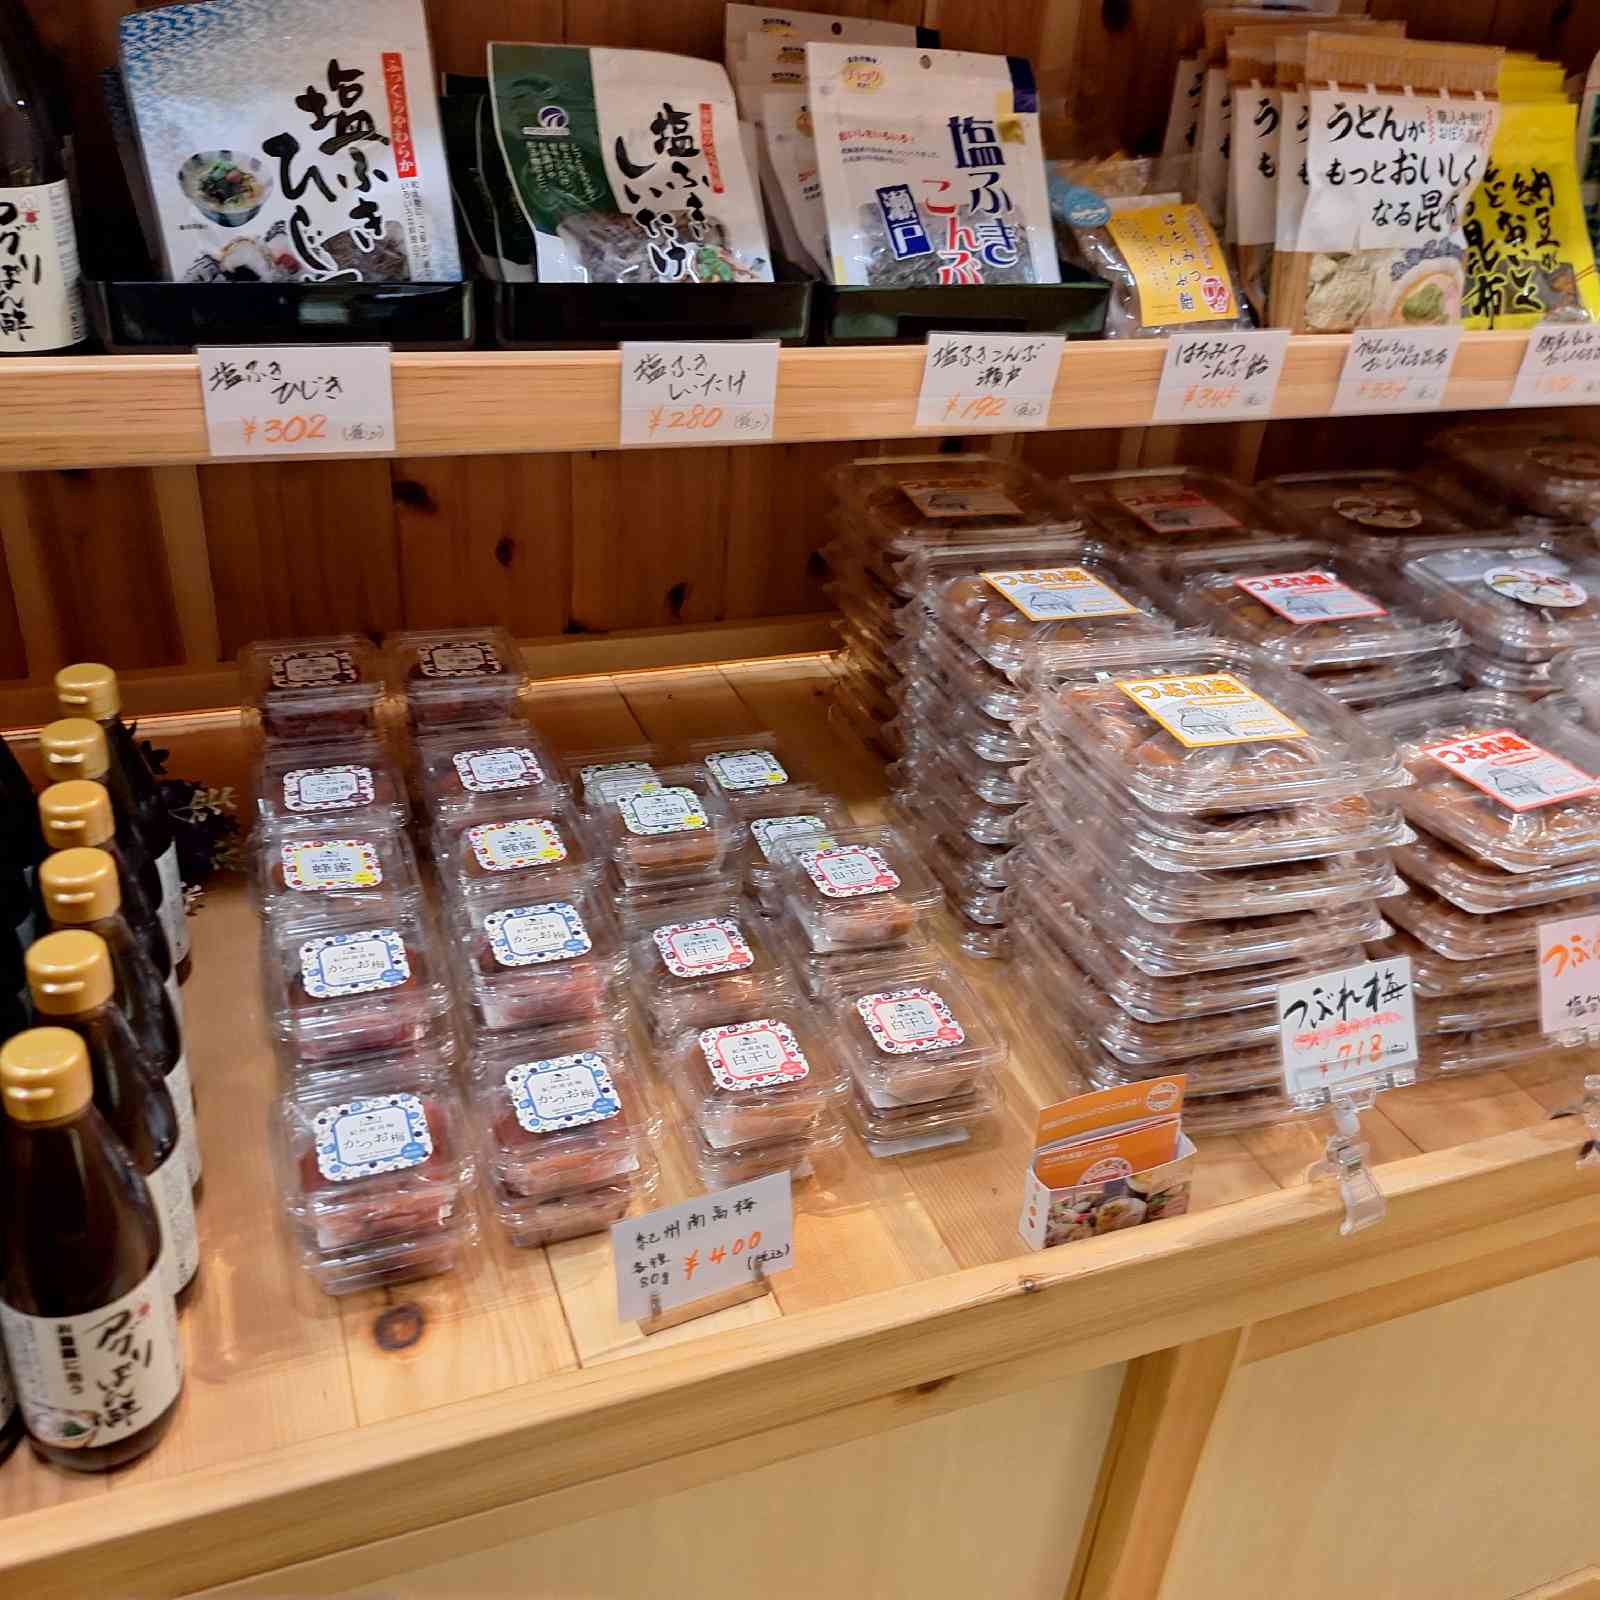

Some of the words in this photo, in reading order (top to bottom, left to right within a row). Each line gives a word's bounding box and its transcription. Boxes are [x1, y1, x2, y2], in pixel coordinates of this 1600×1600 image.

[1327, 102, 1426, 143] うどんが
[296, 58, 391, 253] 塩ふき
[650, 103, 712, 241] 塩ふき
[1326, 148, 1478, 187] もっとおいしく
[947, 115, 1017, 267] 塩ふき
[881, 188, 932, 258] 瀬戸
[922, 179, 984, 284] こんぶ
[209, 360, 282, 391] 塩ふき
[633, 353, 708, 385] 塩ふき
[669, 370, 746, 400] しいたけ
[271, 376, 343, 404] ひじき
[240, 415, 327, 445] ¥302
[649, 403, 722, 437] ¥280
[1283, 968, 1408, 1030] つぶれ梅
[733, 1049, 777, 1066] 白干し
[635, 1197, 757, 1250] 紀州南高梅
[682, 1231, 763, 1280] ¥400
